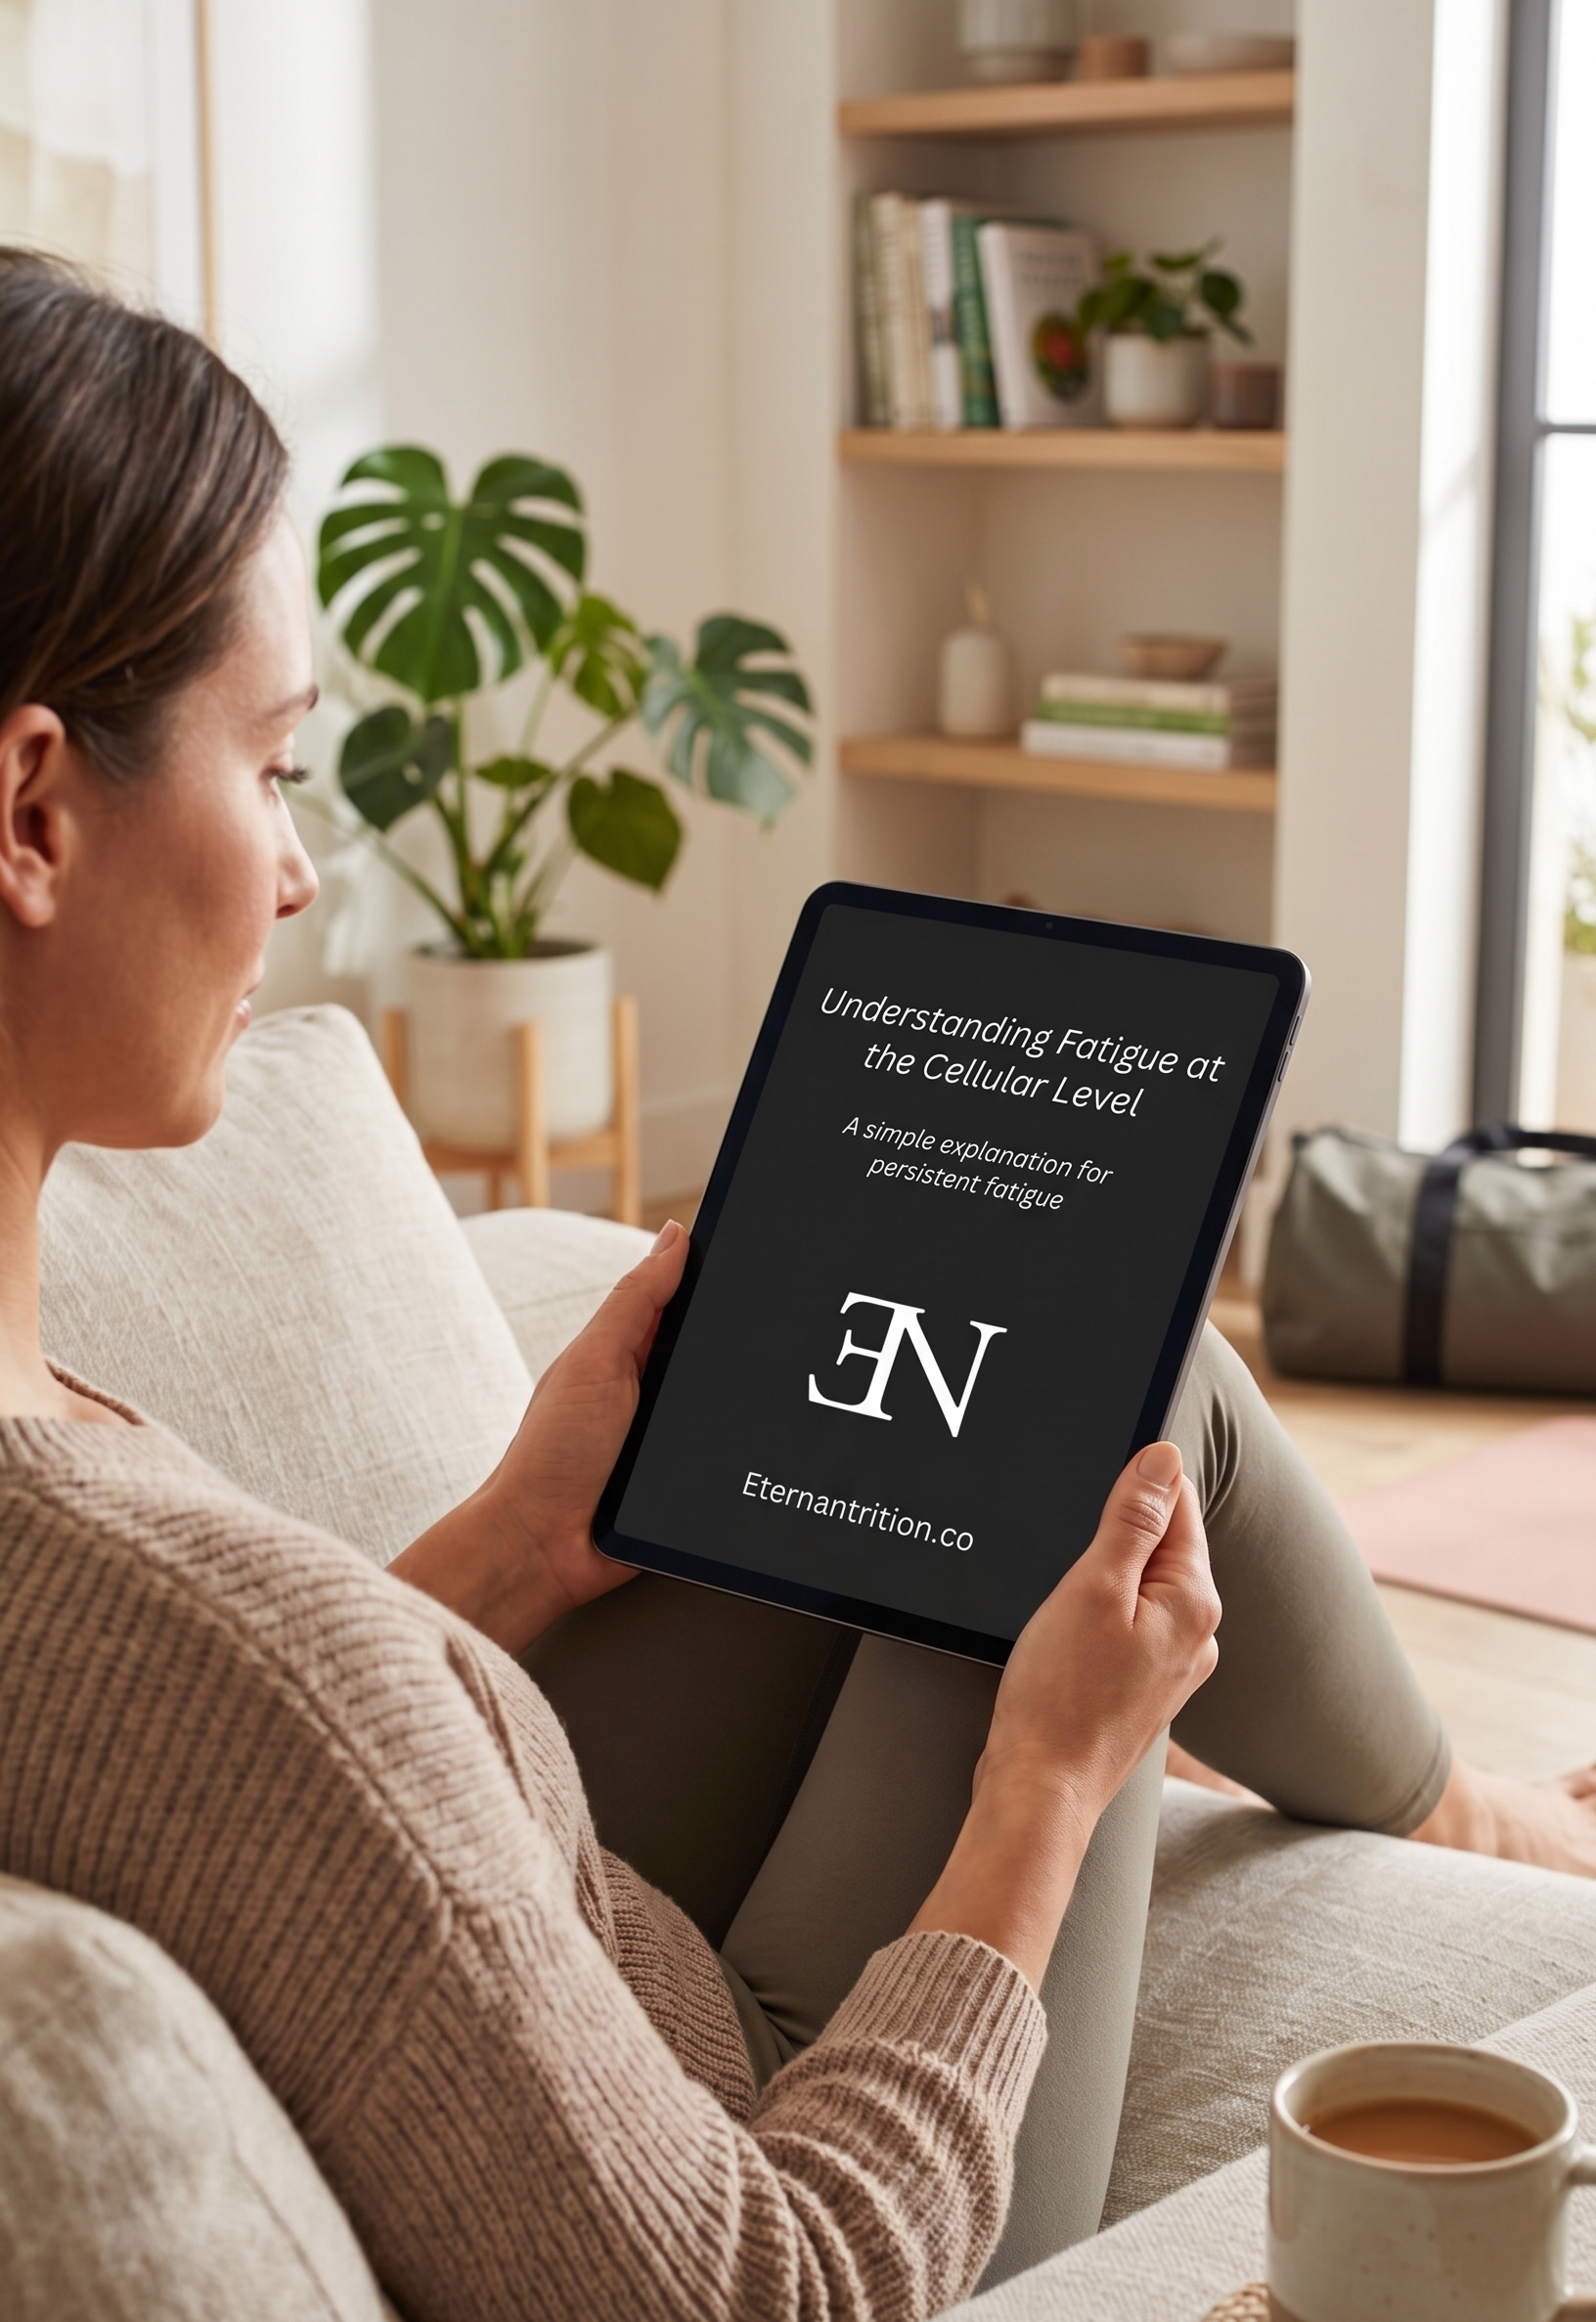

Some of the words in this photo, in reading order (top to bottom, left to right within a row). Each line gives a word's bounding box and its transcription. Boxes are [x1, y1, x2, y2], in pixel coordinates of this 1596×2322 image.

[820, 987, 1054, 1058] Understanding
[1055, 1028, 1179, 1075] Fatigue
[1186, 1055, 1226, 1083] at
[864, 1043, 916, 1075] the
[923, 1053, 1050, 1098] Cellular
[1051, 1076, 1145, 1118] Level
[841, 1116, 860, 1137] A
[863, 1121, 936, 1150] simple
[939, 1139, 1073, 1178] explanation
[1076, 1159, 1115, 1184] for
[865, 1158, 982, 1194] persistent
[983, 1176, 1064, 1210] fatigue
[741, 1471, 974, 1551] Eternantrition.co
